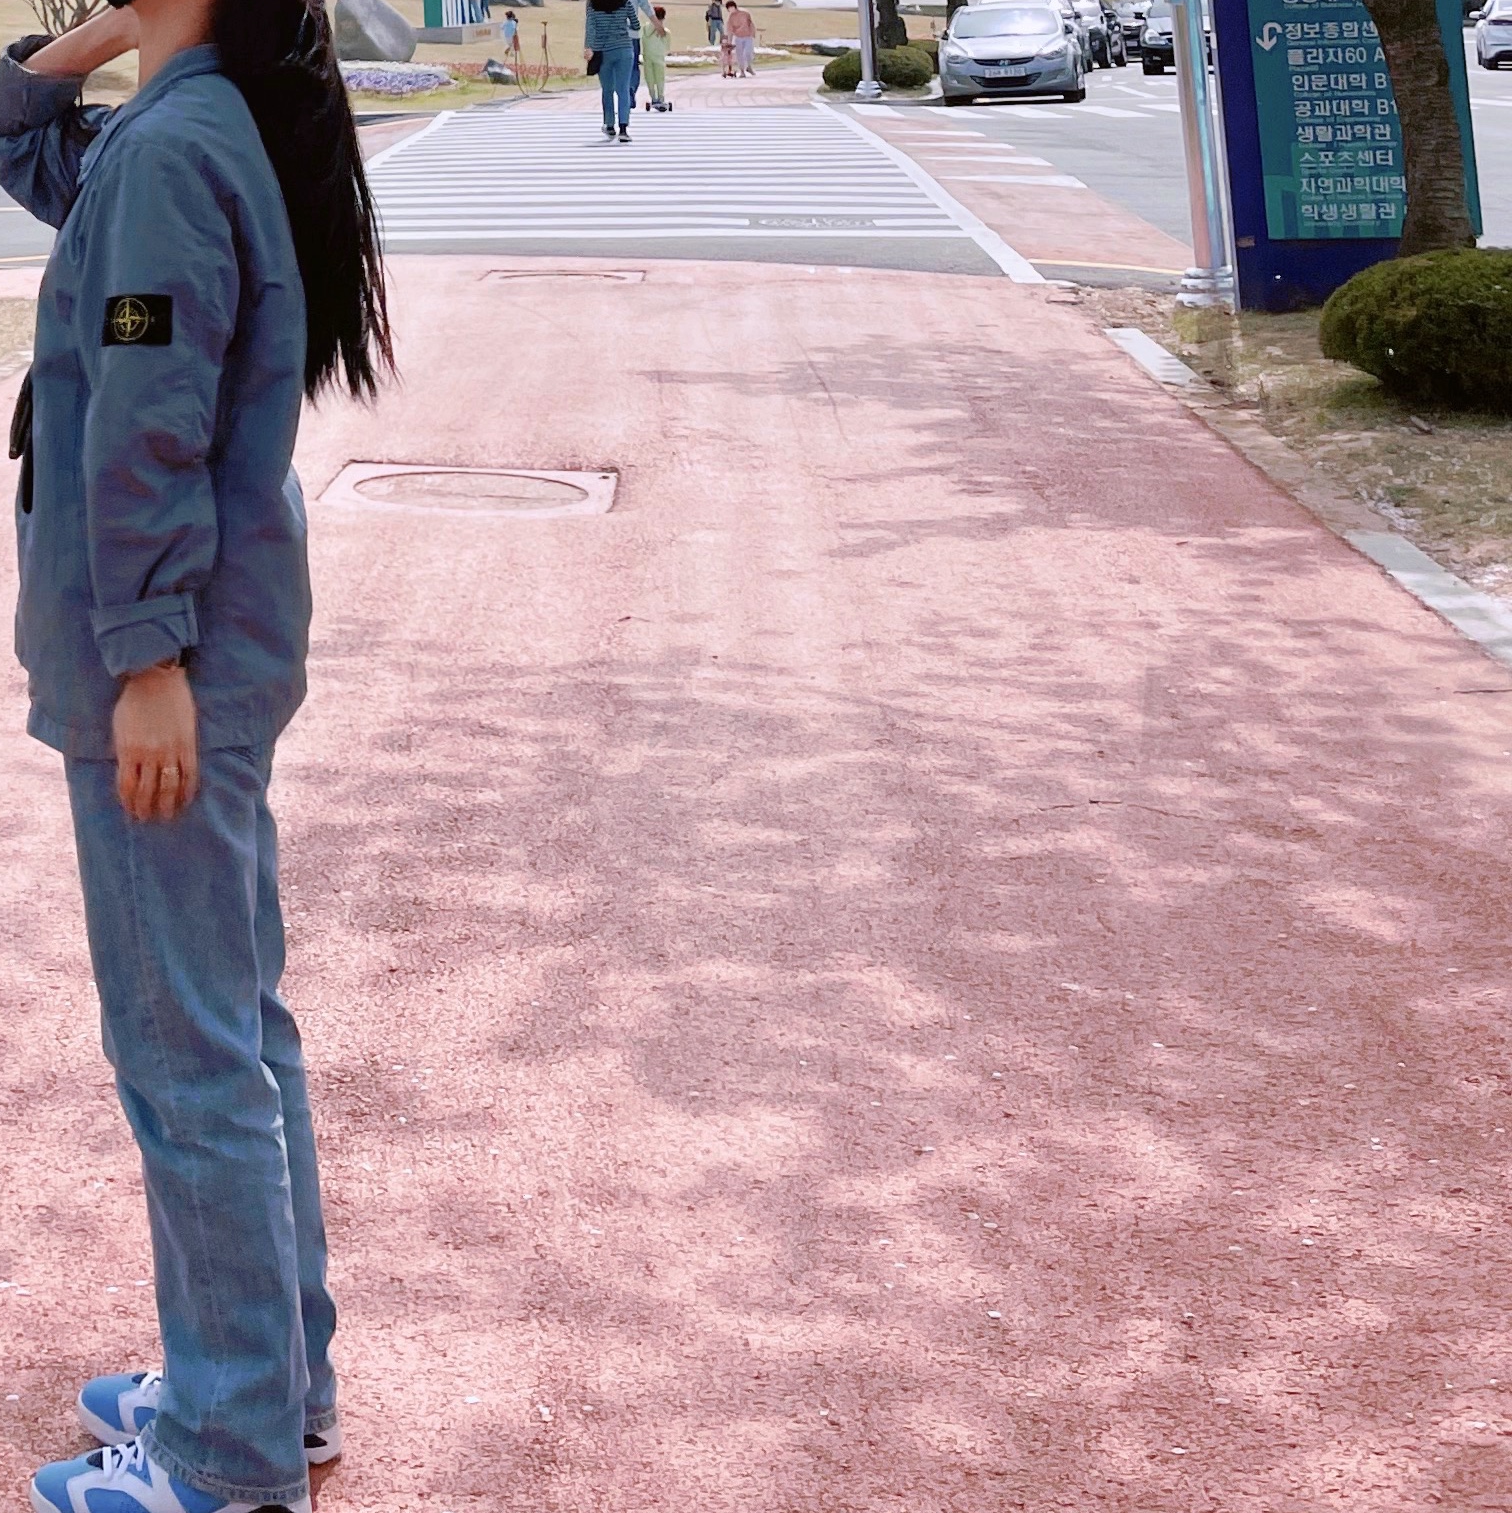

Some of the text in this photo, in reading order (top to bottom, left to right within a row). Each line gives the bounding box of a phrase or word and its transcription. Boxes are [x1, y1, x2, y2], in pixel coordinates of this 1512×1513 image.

[1292, 73, 1367, 91] 인문대학
[1294, 99, 1370, 117] 공과대학
[1299, 150, 1393, 167] 스포츠센터
